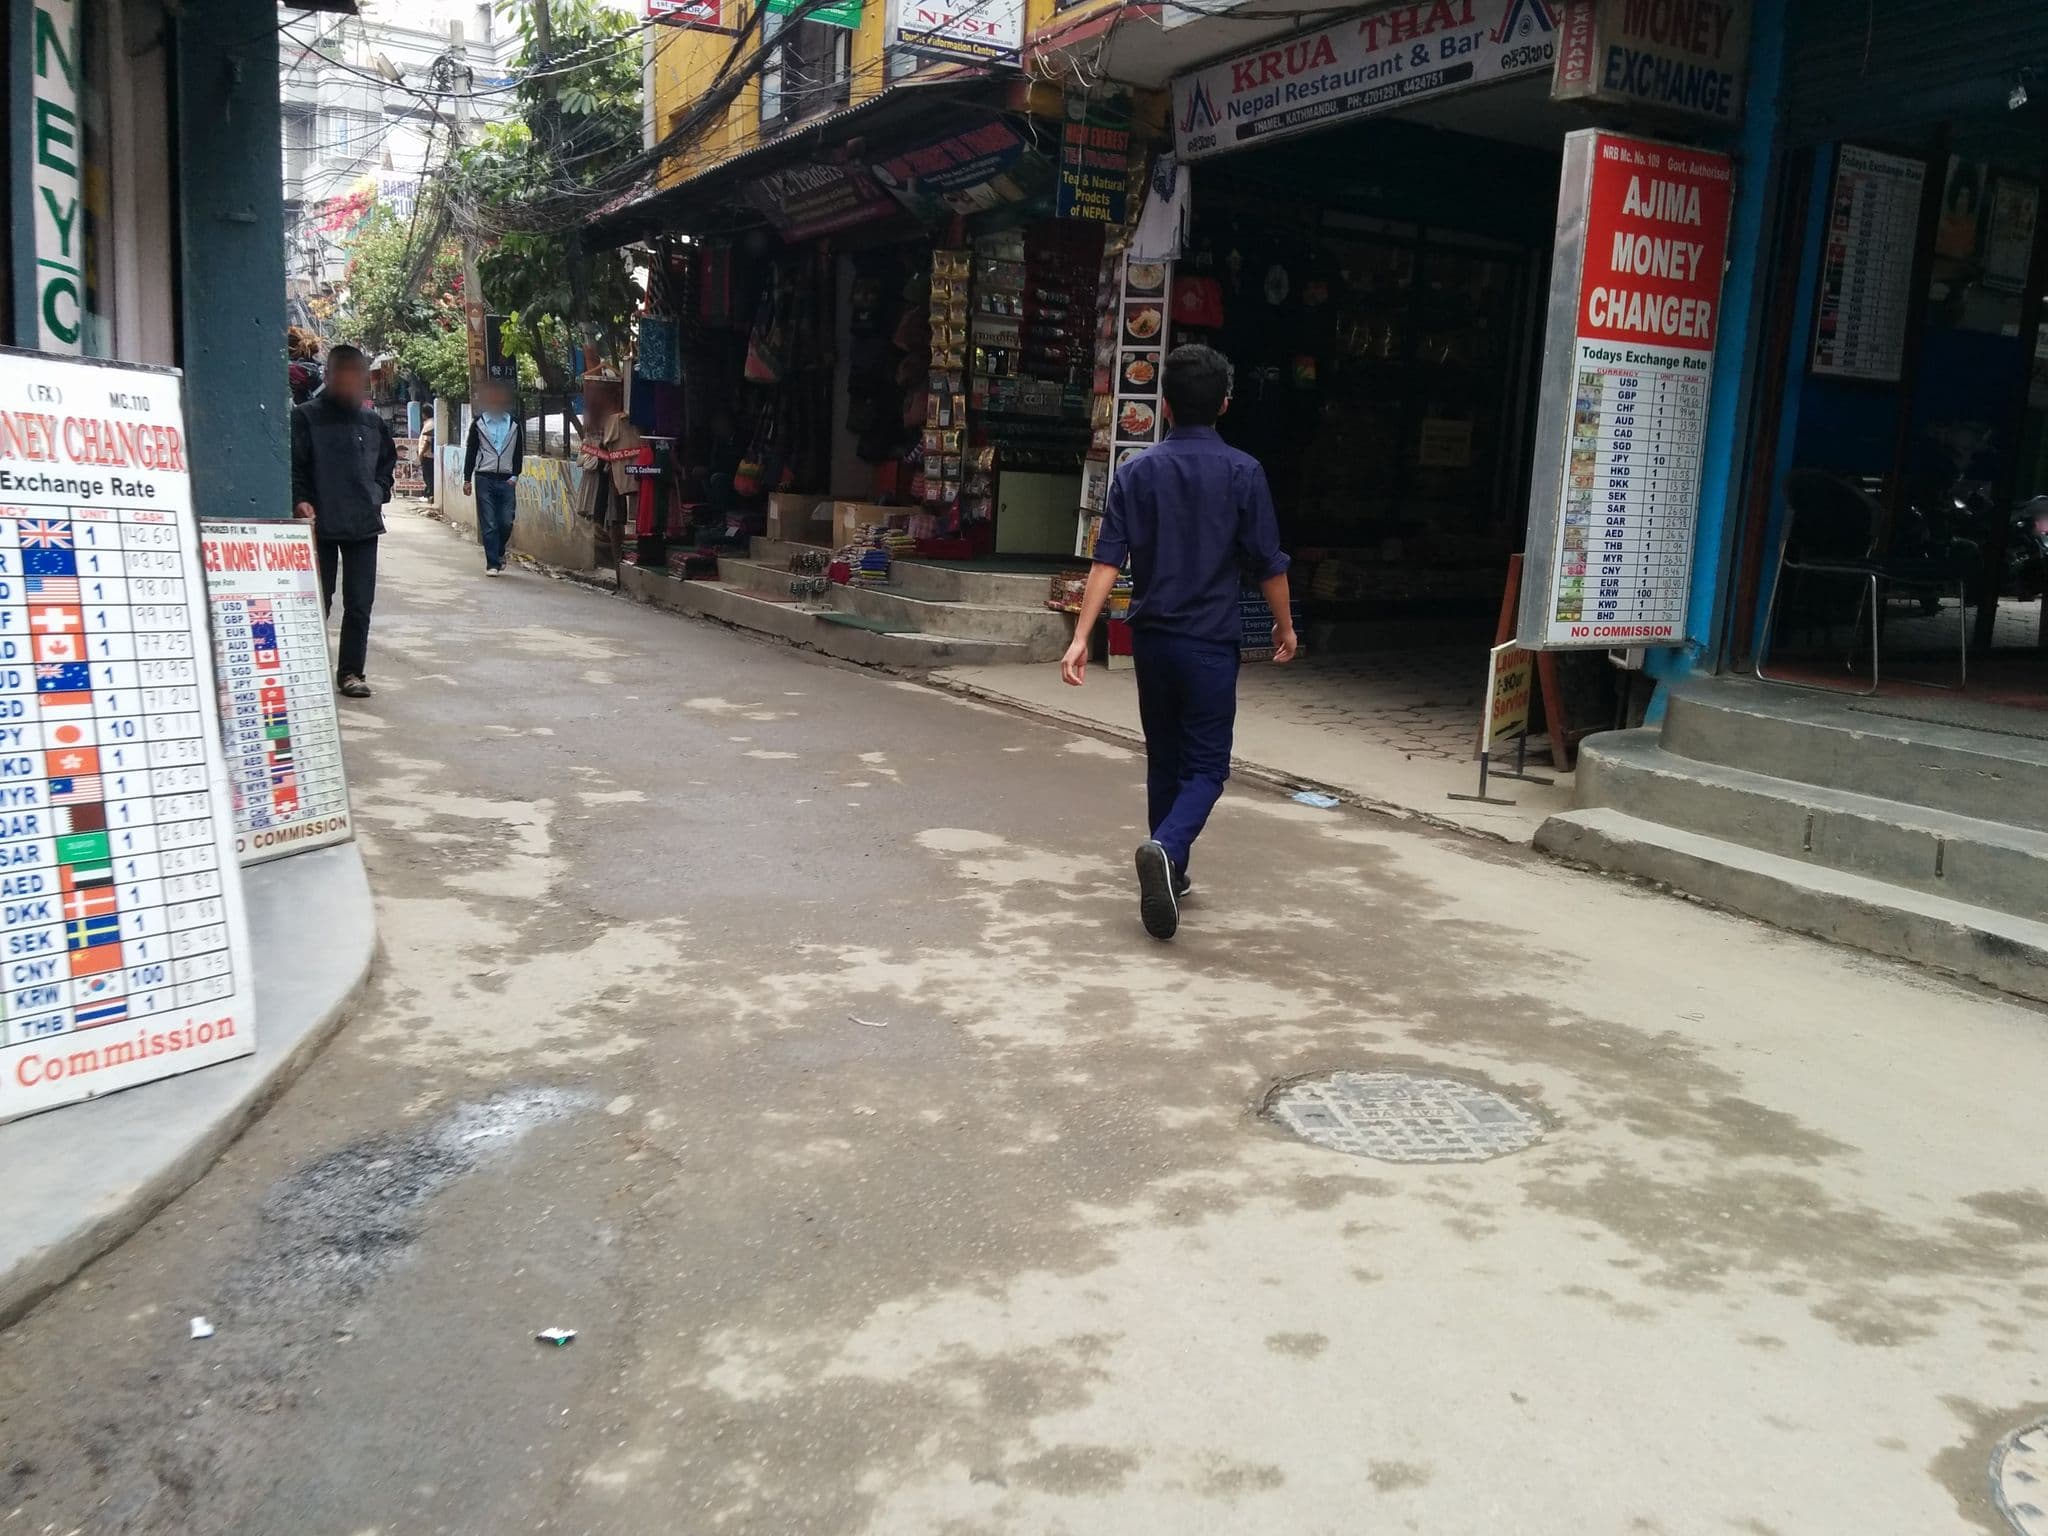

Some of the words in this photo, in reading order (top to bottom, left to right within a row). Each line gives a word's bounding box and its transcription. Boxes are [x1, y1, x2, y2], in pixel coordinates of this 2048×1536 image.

[917, 8, 1002, 36] NEST
[1624, 0, 1734, 59] MONEY
[973, 44, 997, 57] Centre
[1232, 34, 1337, 94] KRUA
[1358, 0, 1475, 52] THAI
[1227, 86, 1280, 120] Nepal
[1285, 53, 1402, 103] Restaurant
[1410, 43, 1430, 67] &
[1440, 31, 1484, 59] Bar
[1604, 45, 1733, 116] EXCHANGE
[1286, 101, 1339, 124] KATHMANDU,
[36, 0, 78, 257] NEY
[1603, 145, 1619, 159] NRB
[1634, 152, 1646, 166] No.
[1667, 157, 1688, 173] Govt.
[1063, 171, 1079, 185] Tea
[1083, 174, 1089, 186] &
[1092, 176, 1125, 191] Natural
[1622, 175, 1702, 225] AJIMA
[1070, 205, 1081, 216] of
[1083, 206, 1112, 221] NEPAL
[1611, 231, 1704, 282] MONEY
[1588, 286, 1711, 340] CHANGER
[1582, 346, 1622, 364] Todays
[1625, 351, 1680, 370] Exchange
[1683, 356, 1707, 370] Rate
[1620, 378, 1638, 388] USD
[1618, 391, 1637, 400] GBP
[1617, 403, 1635, 413] CHF
[1615, 416, 1634, 425] AUD
[1614, 428, 1632, 438] CAD
[63, 416, 187, 472] CHANGER
[1613, 441, 1631, 451] SGD
[1611, 454, 1629, 464] JPY
[1610, 467, 1630, 476] HKD
[0, 471, 103, 498] Exchange
[111, 478, 155, 498] Rate
[1609, 480, 1629, 489] DKK
[1608, 492, 1627, 501] SEK
[133, 512, 165, 522] CASH
[1607, 505, 1626, 514] SAR
[1606, 517, 1626, 526] QAR
[86, 526, 97, 545] 1
[1605, 530, 1624, 539] AED
[1647, 531, 1651, 540] 1
[1604, 542, 1623, 551] THB
[1645, 542, 1650, 551] 1
[89, 555, 100, 573] 1
[221, 542, 262, 572] MONEY
[263, 542, 314, 572] CHANGER
[1603, 554, 1623, 564] MYR
[1644, 555, 1649, 564] 1
[1602, 567, 1621, 576] CNY
[1643, 567, 1648, 576] 1
[93, 583, 104, 600] 1
[1601, 579, 1619, 588] EUR
[1642, 579, 1646, 588] 1
[1599, 589, 1619, 598] KRW
[1637, 590, 1652, 598] 100
[222, 602, 242, 611] USD
[1598, 601, 1618, 610] KWD
[1639, 600, 1644, 609] 1
[97, 611, 106, 628] 1
[224, 614, 244, 624] GBP
[1597, 612, 1615, 621] BHD
[1638, 612, 1642, 621] 1
[226, 628, 246, 637] EUR
[1571, 626, 1589, 637] NO
[1593, 626, 1672, 637] COMMISSION
[100, 639, 110, 656] 1
[228, 641, 249, 650] AUD
[230, 654, 250, 663] CAD
[104, 667, 114, 684] 1
[232, 666, 252, 676] SGD
[235, 693, 256, 702] HKD
[0, 700, 24, 718] GD
[108, 695, 118, 711] 1
[237, 705, 258, 715] DKK
[239, 718, 258, 728] SEK
[0, 727, 23, 746] PY
[111, 721, 135, 738] 10
[241, 731, 259, 741] SAR
[0, 757, 33, 777] KD
[114, 750, 124, 766] 1
[244, 756, 264, 766] AED
[0, 786, 37, 804] YR
[118, 777, 127, 794] 1
[121, 804, 130, 822] 1
[124, 833, 133, 850] 1
[236, 839, 246, 853] O
[254, 816, 348, 849] COMMISSION
[1, 874, 43, 898] AED
[127, 860, 137, 878] 1
[5, 901, 50, 925] DKK
[130, 886, 140, 904] 1
[10, 931, 53, 955] SEK
[134, 914, 144, 932] 1
[13, 960, 57, 984] CNY
[138, 942, 147, 960] 1
[16, 988, 60, 1010] KRW
[131, 965, 164, 987] 100
[21, 1015, 64, 1039] THB
[146, 995, 155, 1011] 1
[16, 1015, 236, 1087] Commission
